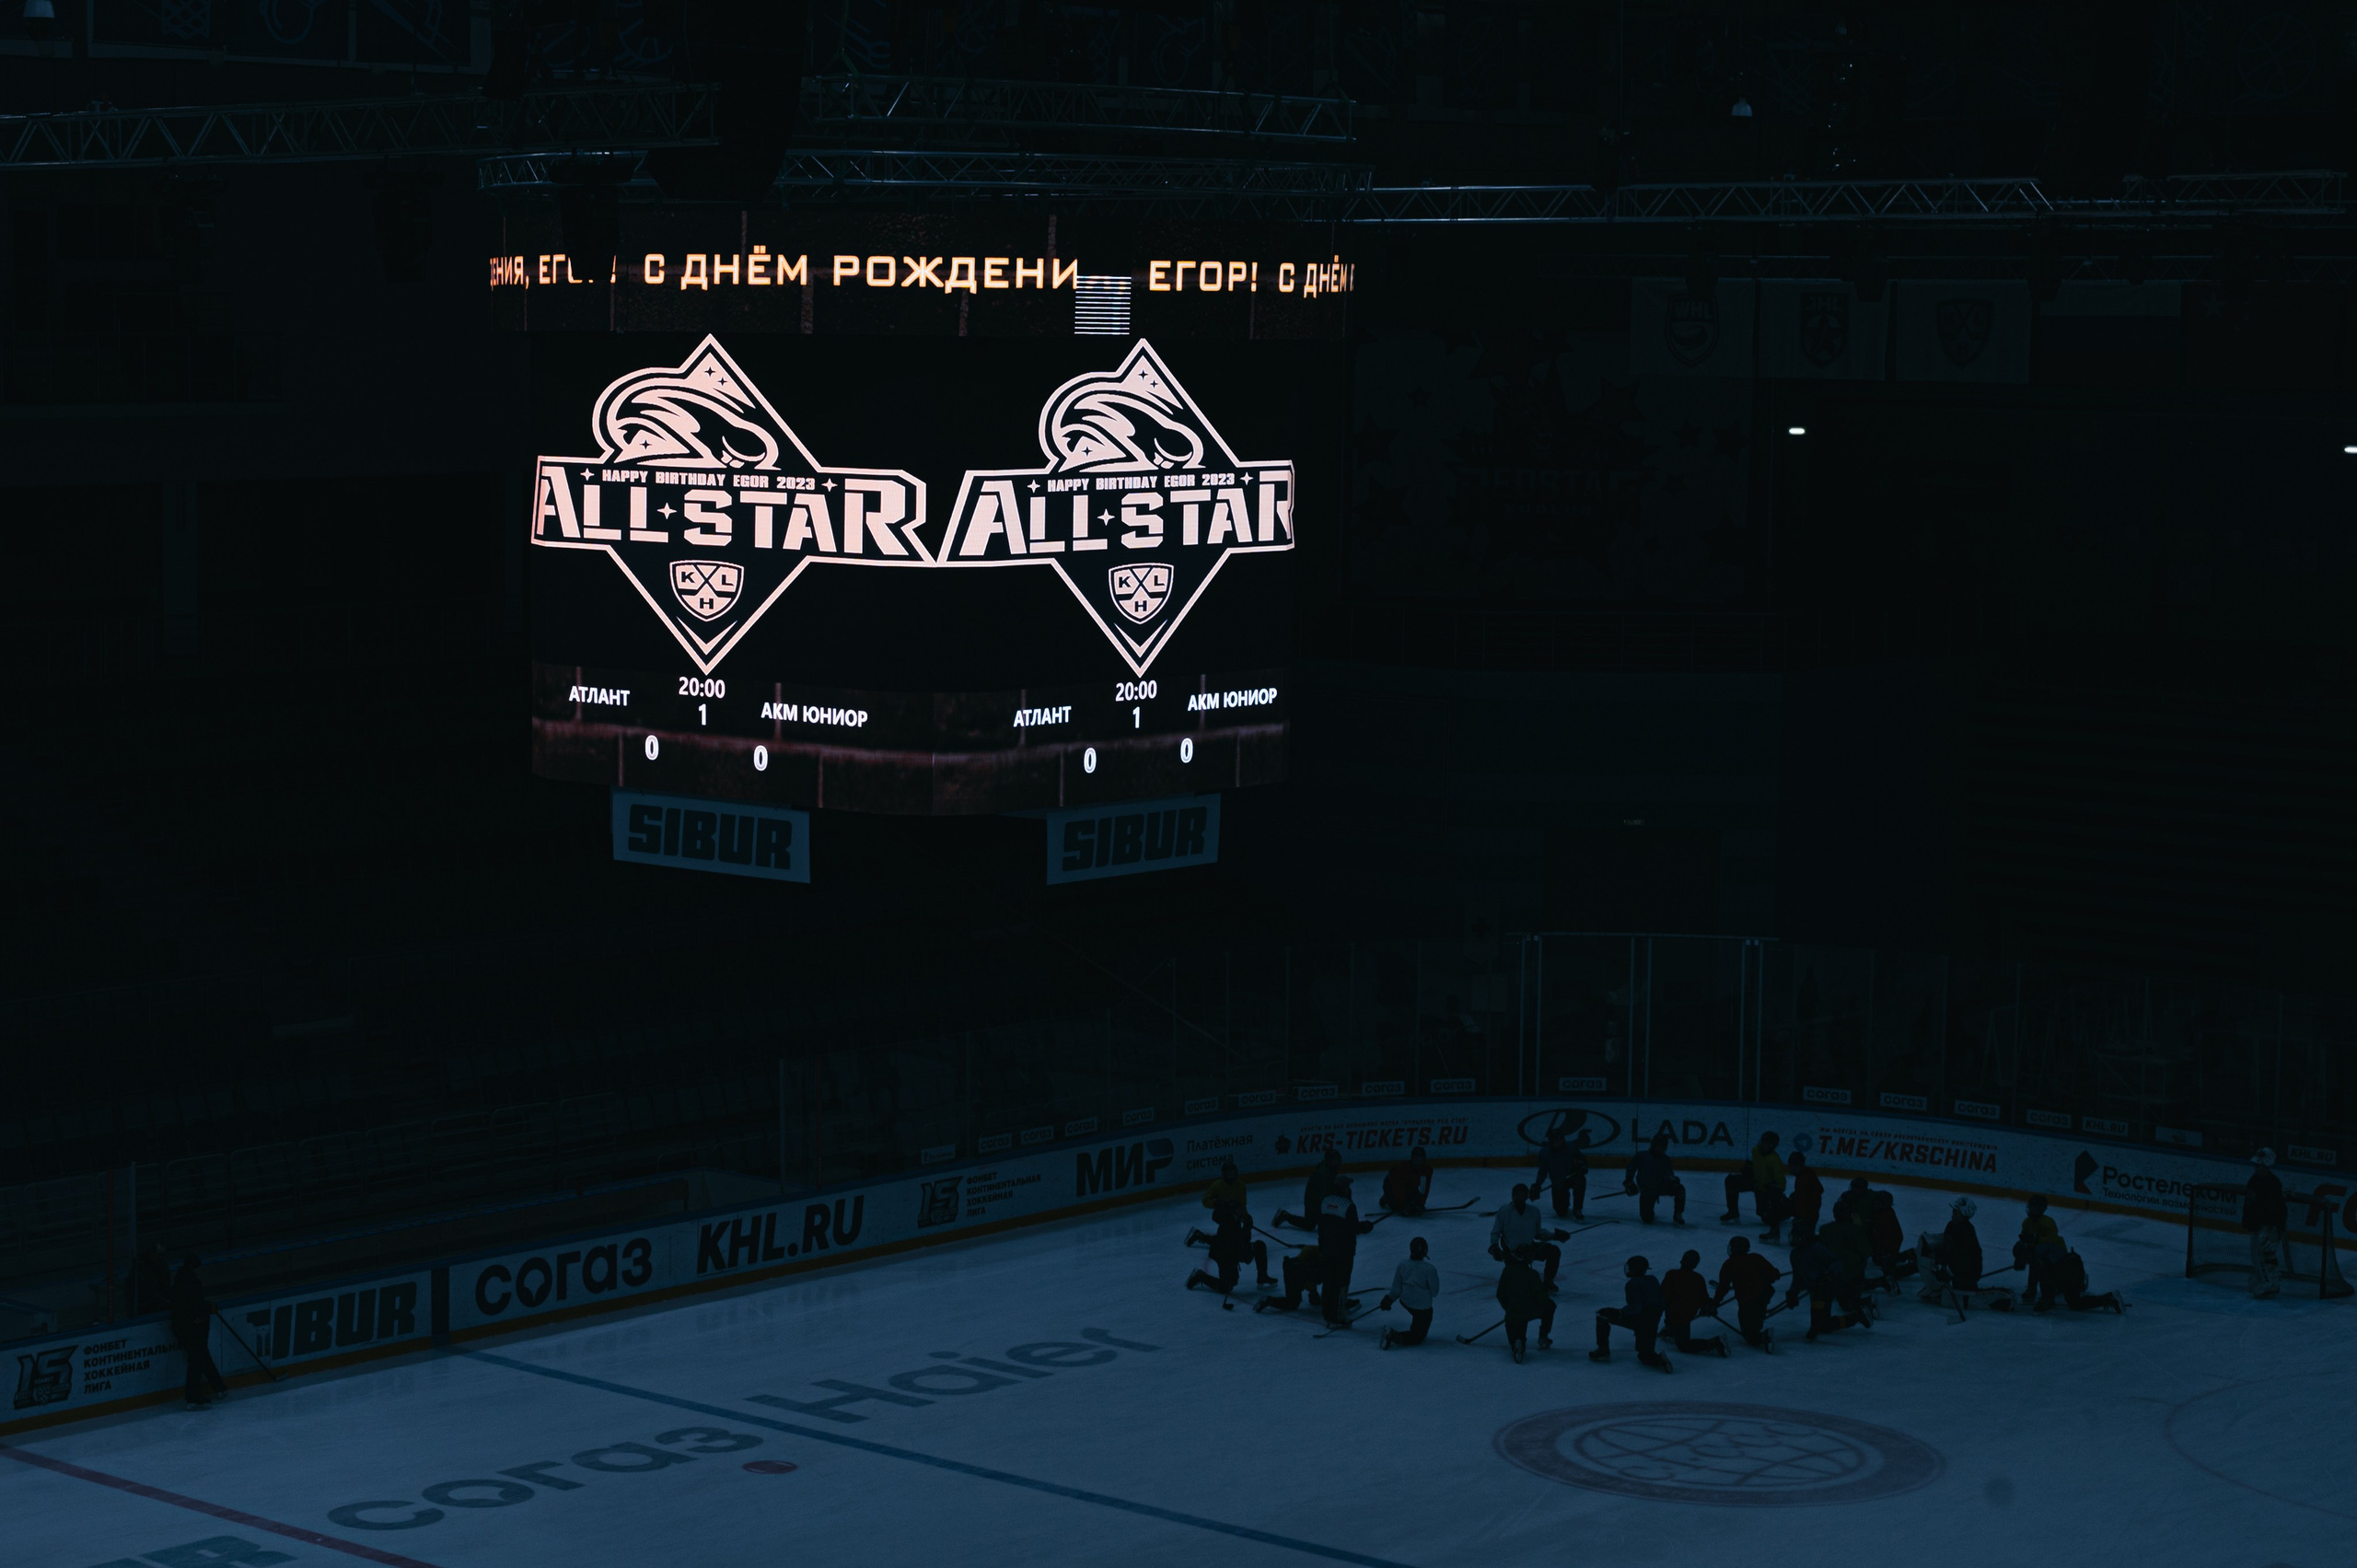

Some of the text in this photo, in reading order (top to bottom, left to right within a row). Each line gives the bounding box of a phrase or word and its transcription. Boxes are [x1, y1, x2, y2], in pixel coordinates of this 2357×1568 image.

[644, 254, 665, 285] С
[680, 245, 808, 291] ДНЁМ
[1149, 260, 1258, 292] ЕГОР!
[1278, 261, 1295, 293] С
[602, 469, 816, 491] HAPPY BIRTHDAY EGOR 2023
[1047, 472, 1236, 493] HAPPY BIRTHDAY EGOR 2023
[569, 685, 630, 706] АТЛАНТ
[679, 677, 726, 699] 20:00
[1115, 679, 1157, 702] 20:00
[1188, 687, 1278, 712] АКМ ЮНИОР
[698, 703, 707, 726] 1
[761, 702, 868, 728] АКМ ЮНИОР
[1013, 705, 1072, 727] АТЛАНТ
[1132, 706, 1140, 728] 1
[644, 734, 659, 761] 0
[753, 745, 768, 772] 0
[1180, 738, 1193, 763] 0
[1084, 748, 1097, 773] 0
[629, 804, 793, 871] SIBUR
[1062, 807, 1208, 872] SIBUR
[1187, 1134, 1253, 1154] Платёжная
[1296, 1125, 1469, 1155] KRS-TICKETS.RU
[1631, 1119, 1735, 1147] LADA
[1819, 1134, 1997, 1173] T.ME/KRSCHINA
[1076, 1137, 1175, 1198] МИР
[696, 1194, 865, 1276] KHL.RU
[475, 1237, 653, 1316] согаз
[84, 1339, 128, 1355] ФОНБЕТ
[84, 1360, 150, 1382] ХОККЕЙНАЯ
[748, 1327, 1164, 1423] Haier
[83, 1380, 112, 1394] ЛИГА
[327, 1426, 764, 1530] согаз
